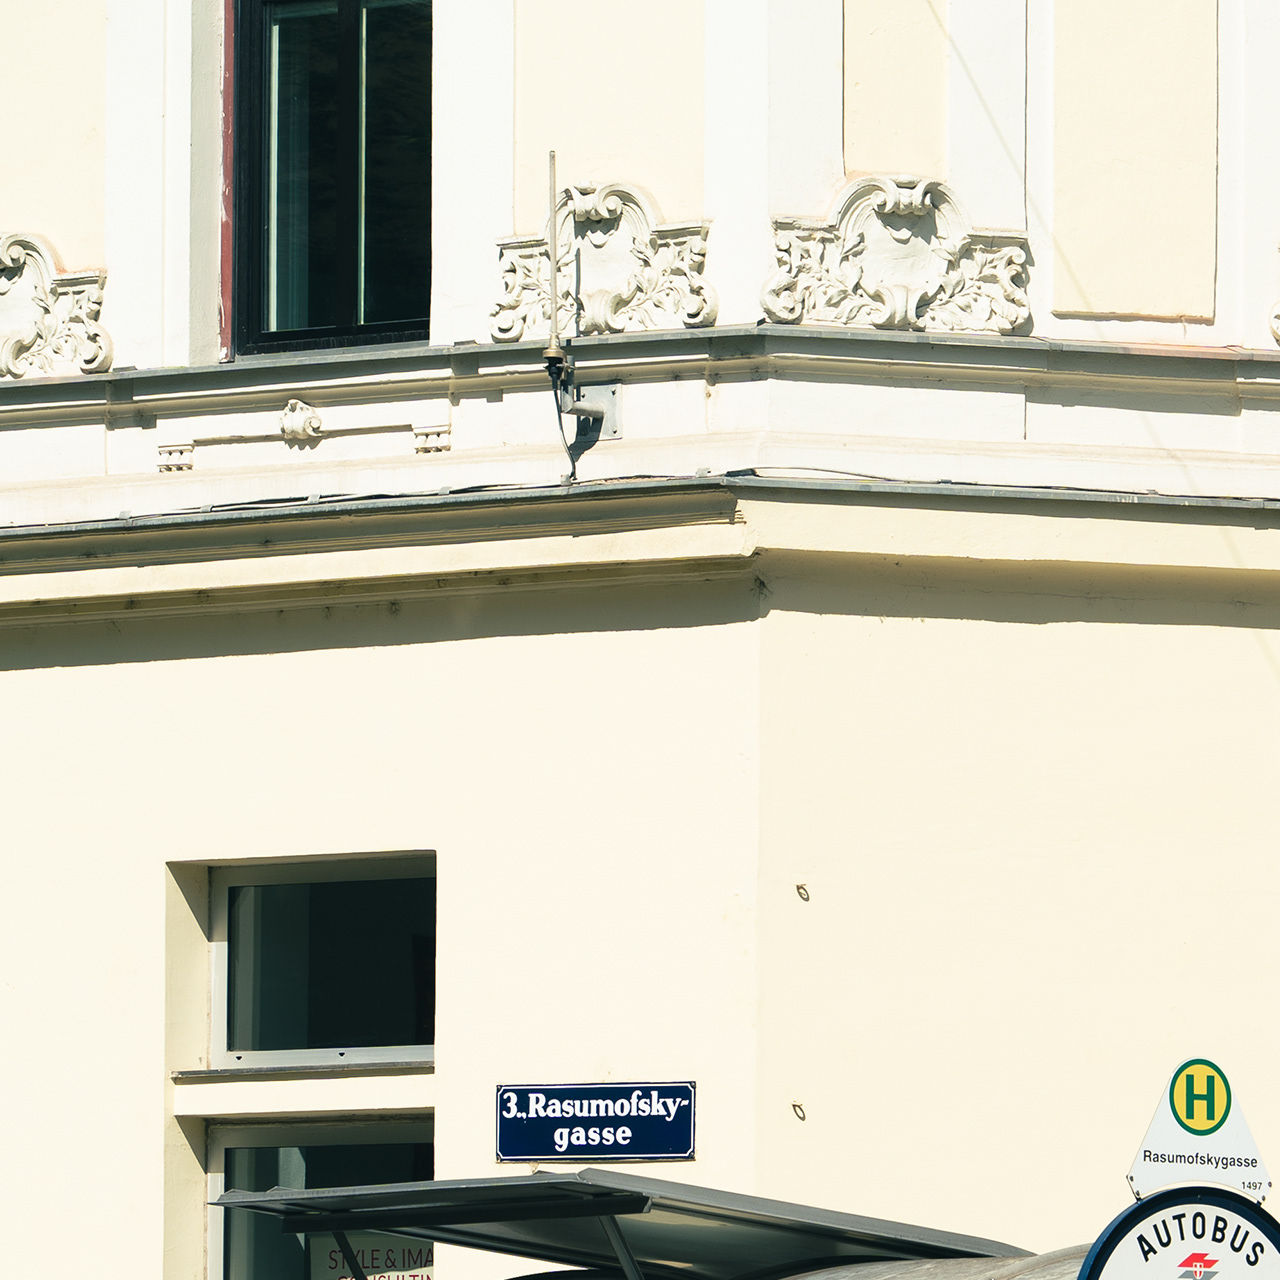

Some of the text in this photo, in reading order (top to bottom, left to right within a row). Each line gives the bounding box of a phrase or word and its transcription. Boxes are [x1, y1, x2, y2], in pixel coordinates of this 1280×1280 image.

[553, 1124, 633, 1152] gasse
[1142, 1149, 1259, 1170] Rasumofskygasse
[1241, 1180, 1264, 1191] 1497
[1136, 1211, 1266, 1267] AUTOBUS
